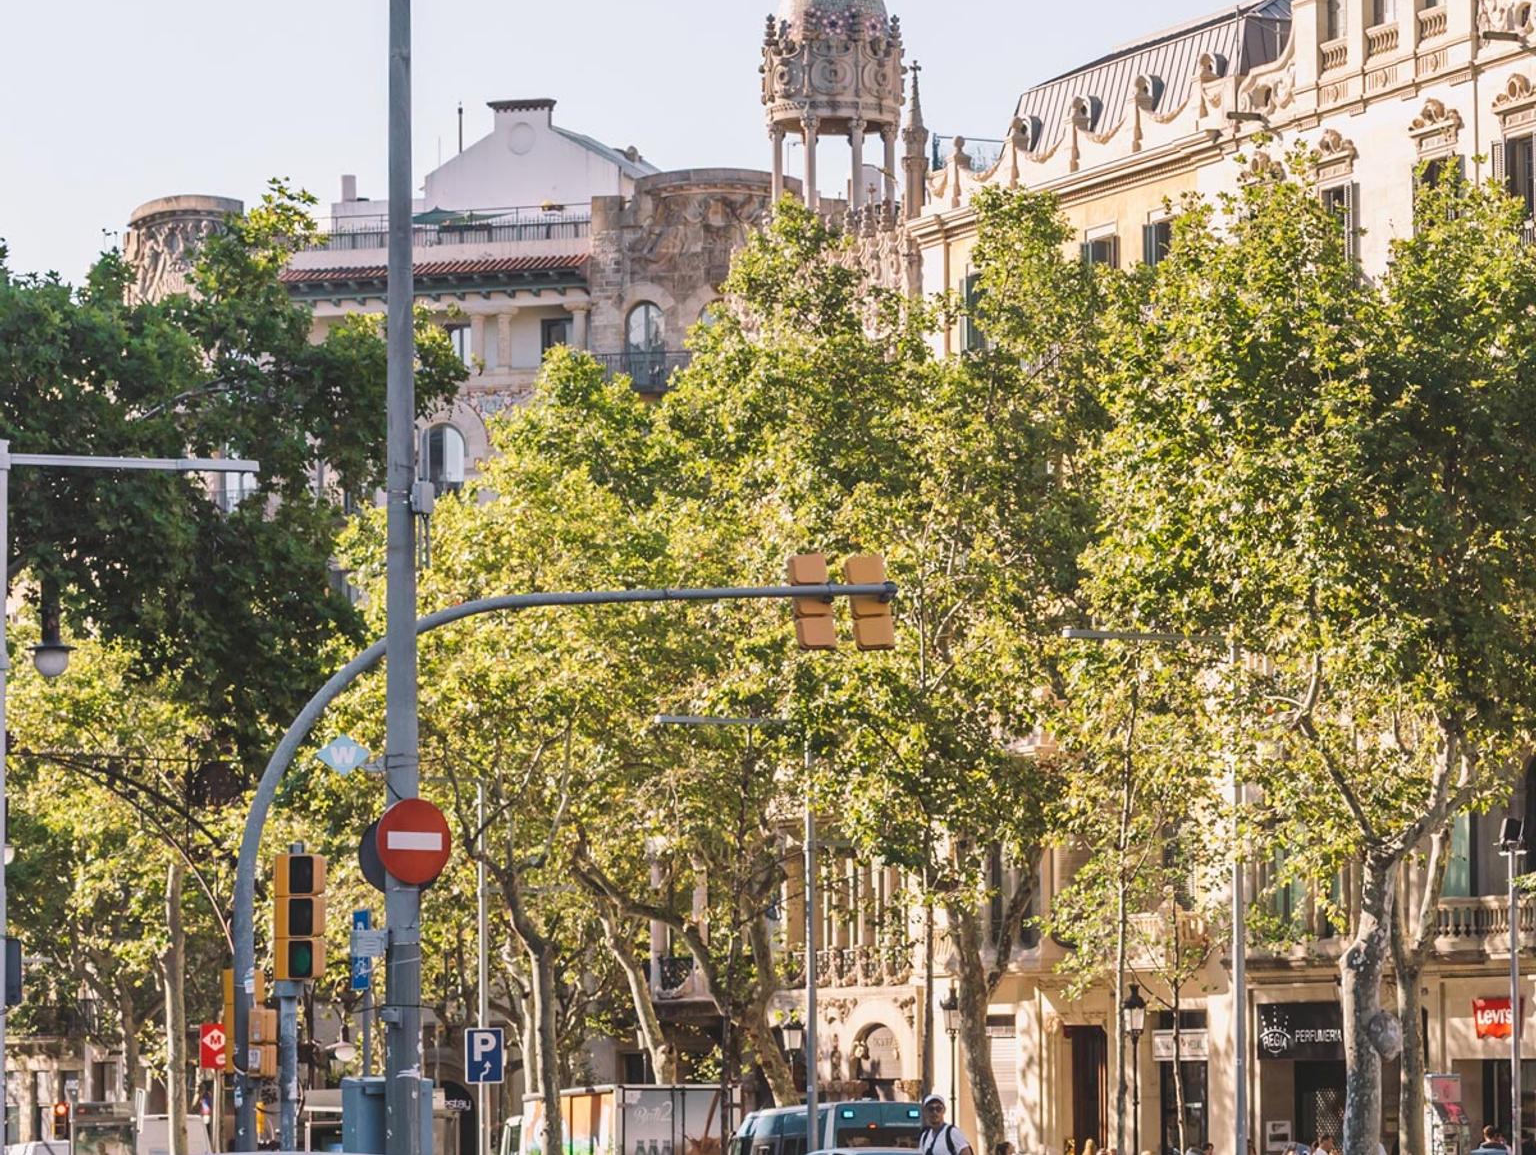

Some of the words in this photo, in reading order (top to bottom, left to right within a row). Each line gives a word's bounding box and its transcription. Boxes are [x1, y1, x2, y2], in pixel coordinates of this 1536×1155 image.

[330, 747, 358, 765] W
[210, 1035, 222, 1045] M
[473, 1032, 497, 1062] P
[1262, 1032, 1287, 1050] REGIA
